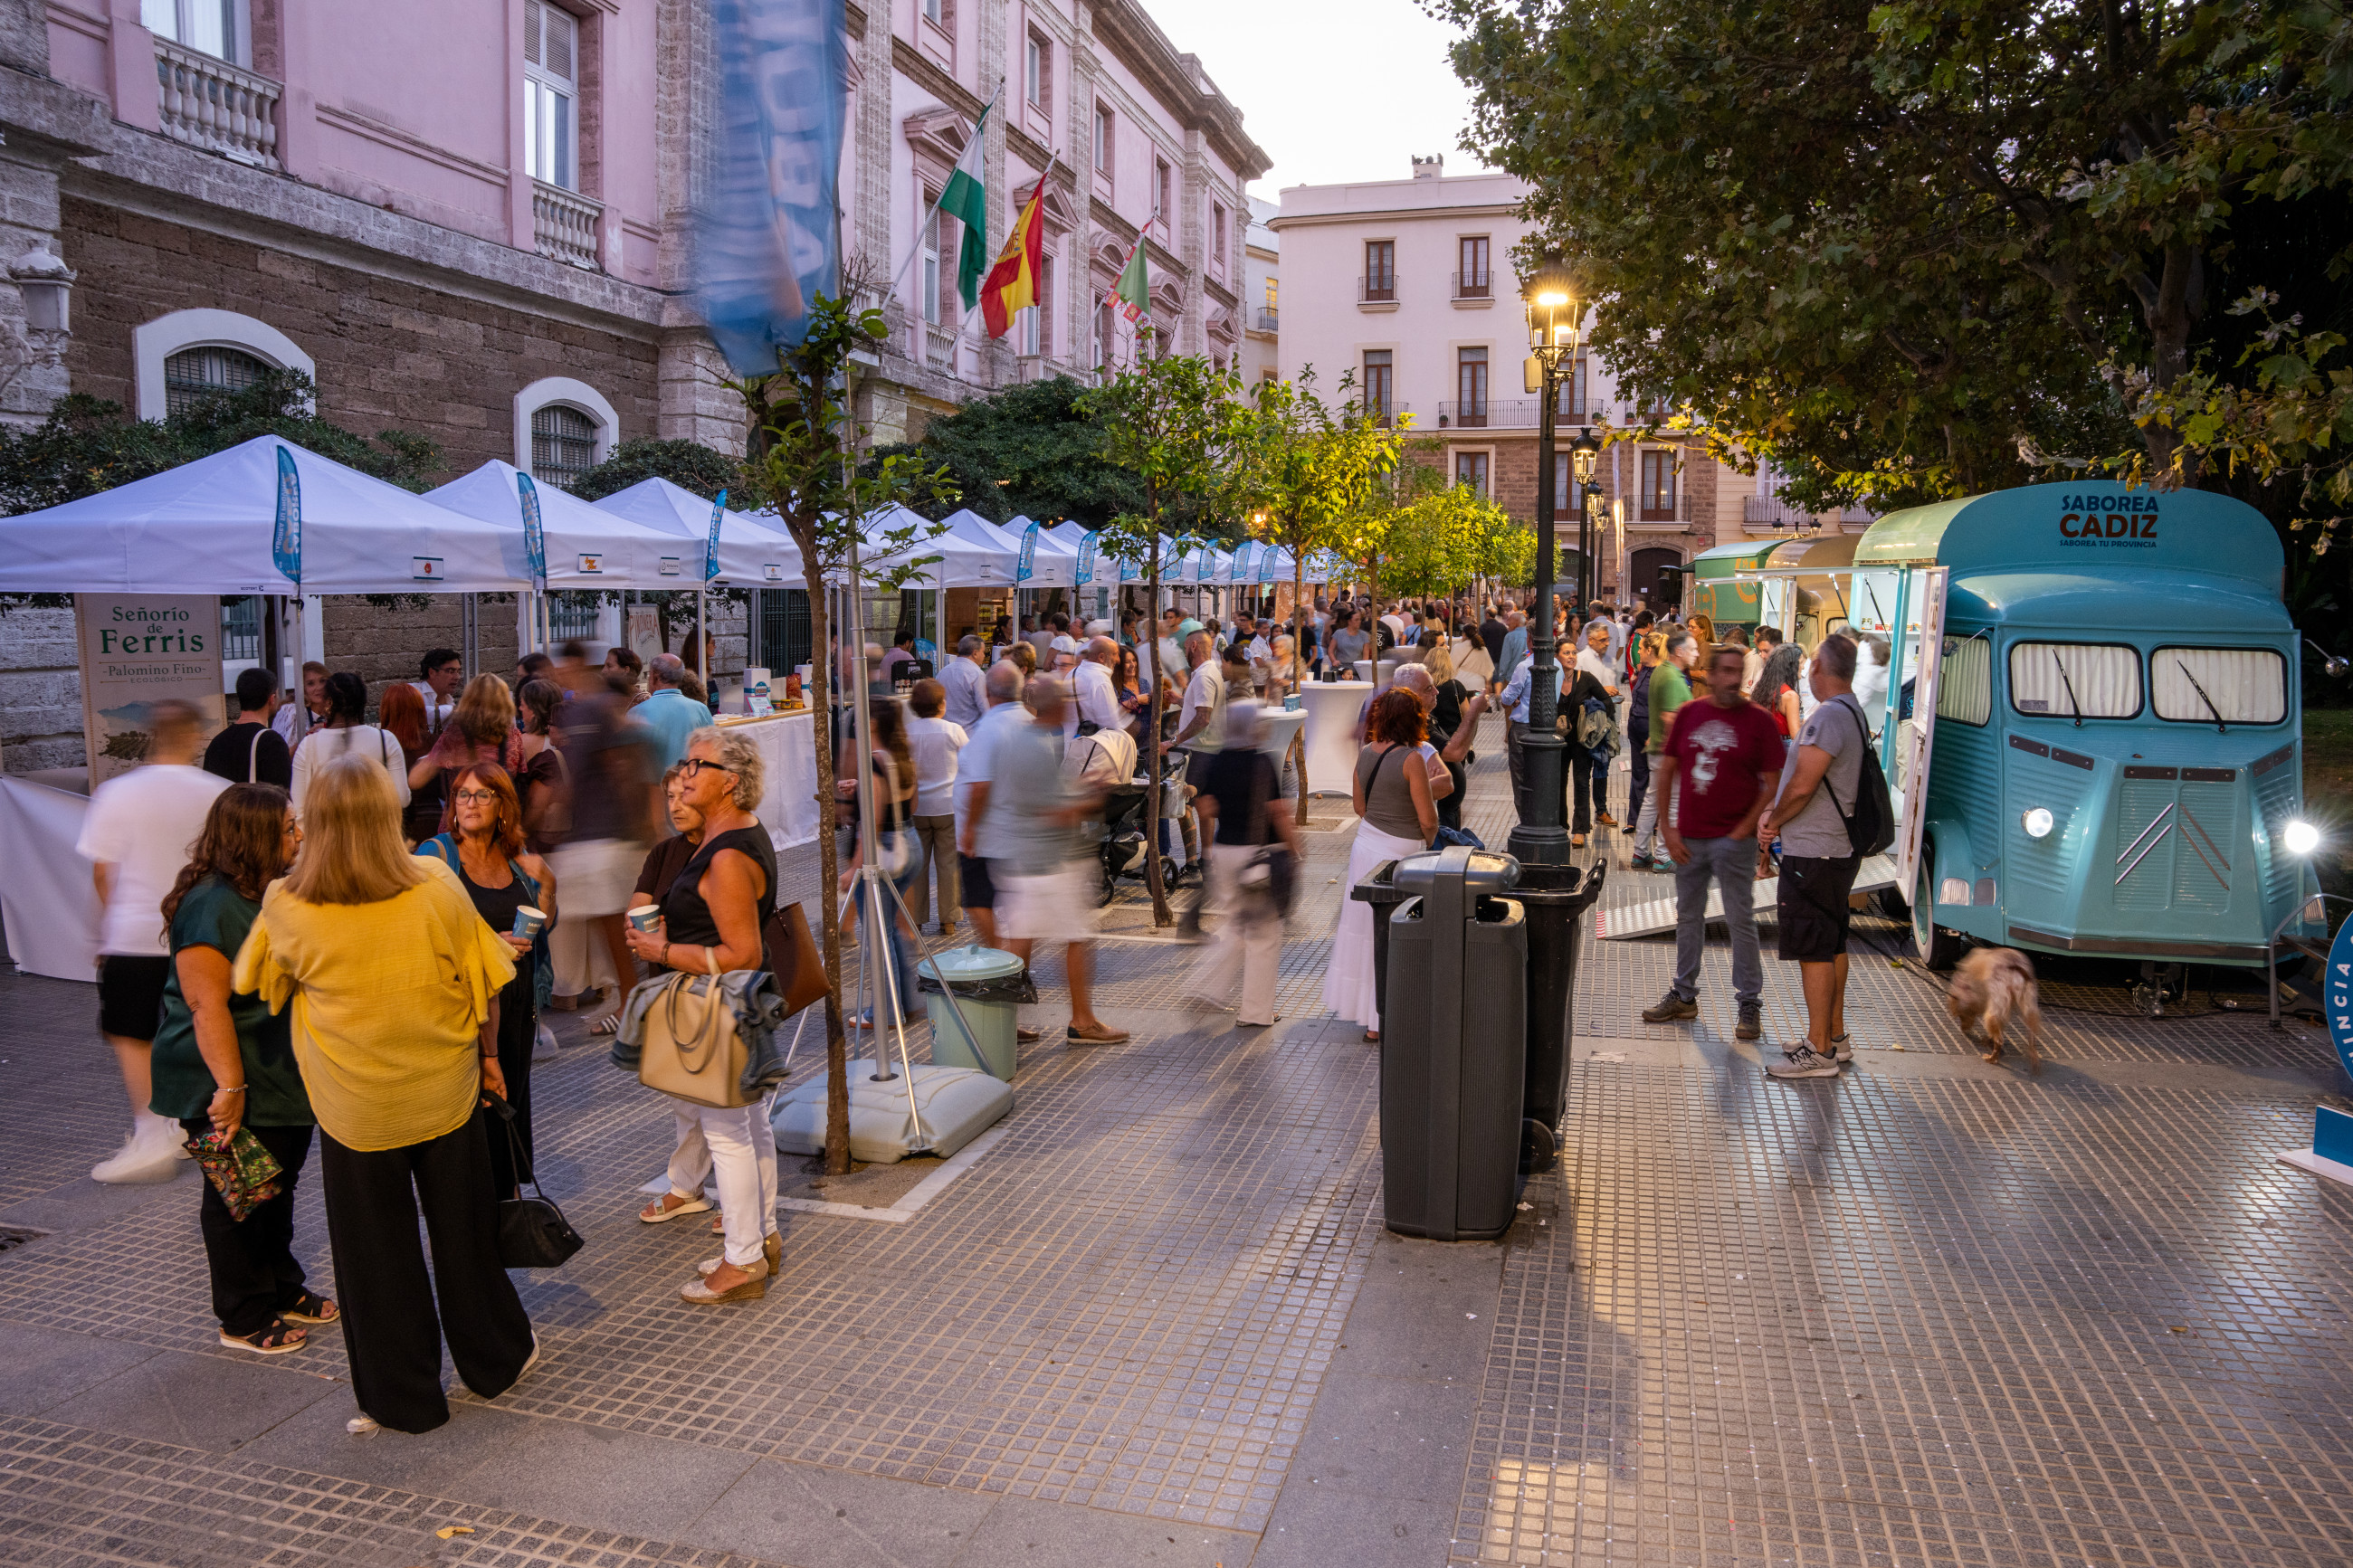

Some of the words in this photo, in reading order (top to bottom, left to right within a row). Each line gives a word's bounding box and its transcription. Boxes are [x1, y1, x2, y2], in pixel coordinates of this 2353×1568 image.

[2062, 495, 2159, 512] SABOREA
[2060, 539, 2097, 547] SABOREA
[2110, 540, 2157, 548] PROVINCIA
[112, 606, 190, 622] Señorío
[147, 623, 163, 634] de
[100, 628, 204, 654] Ferris
